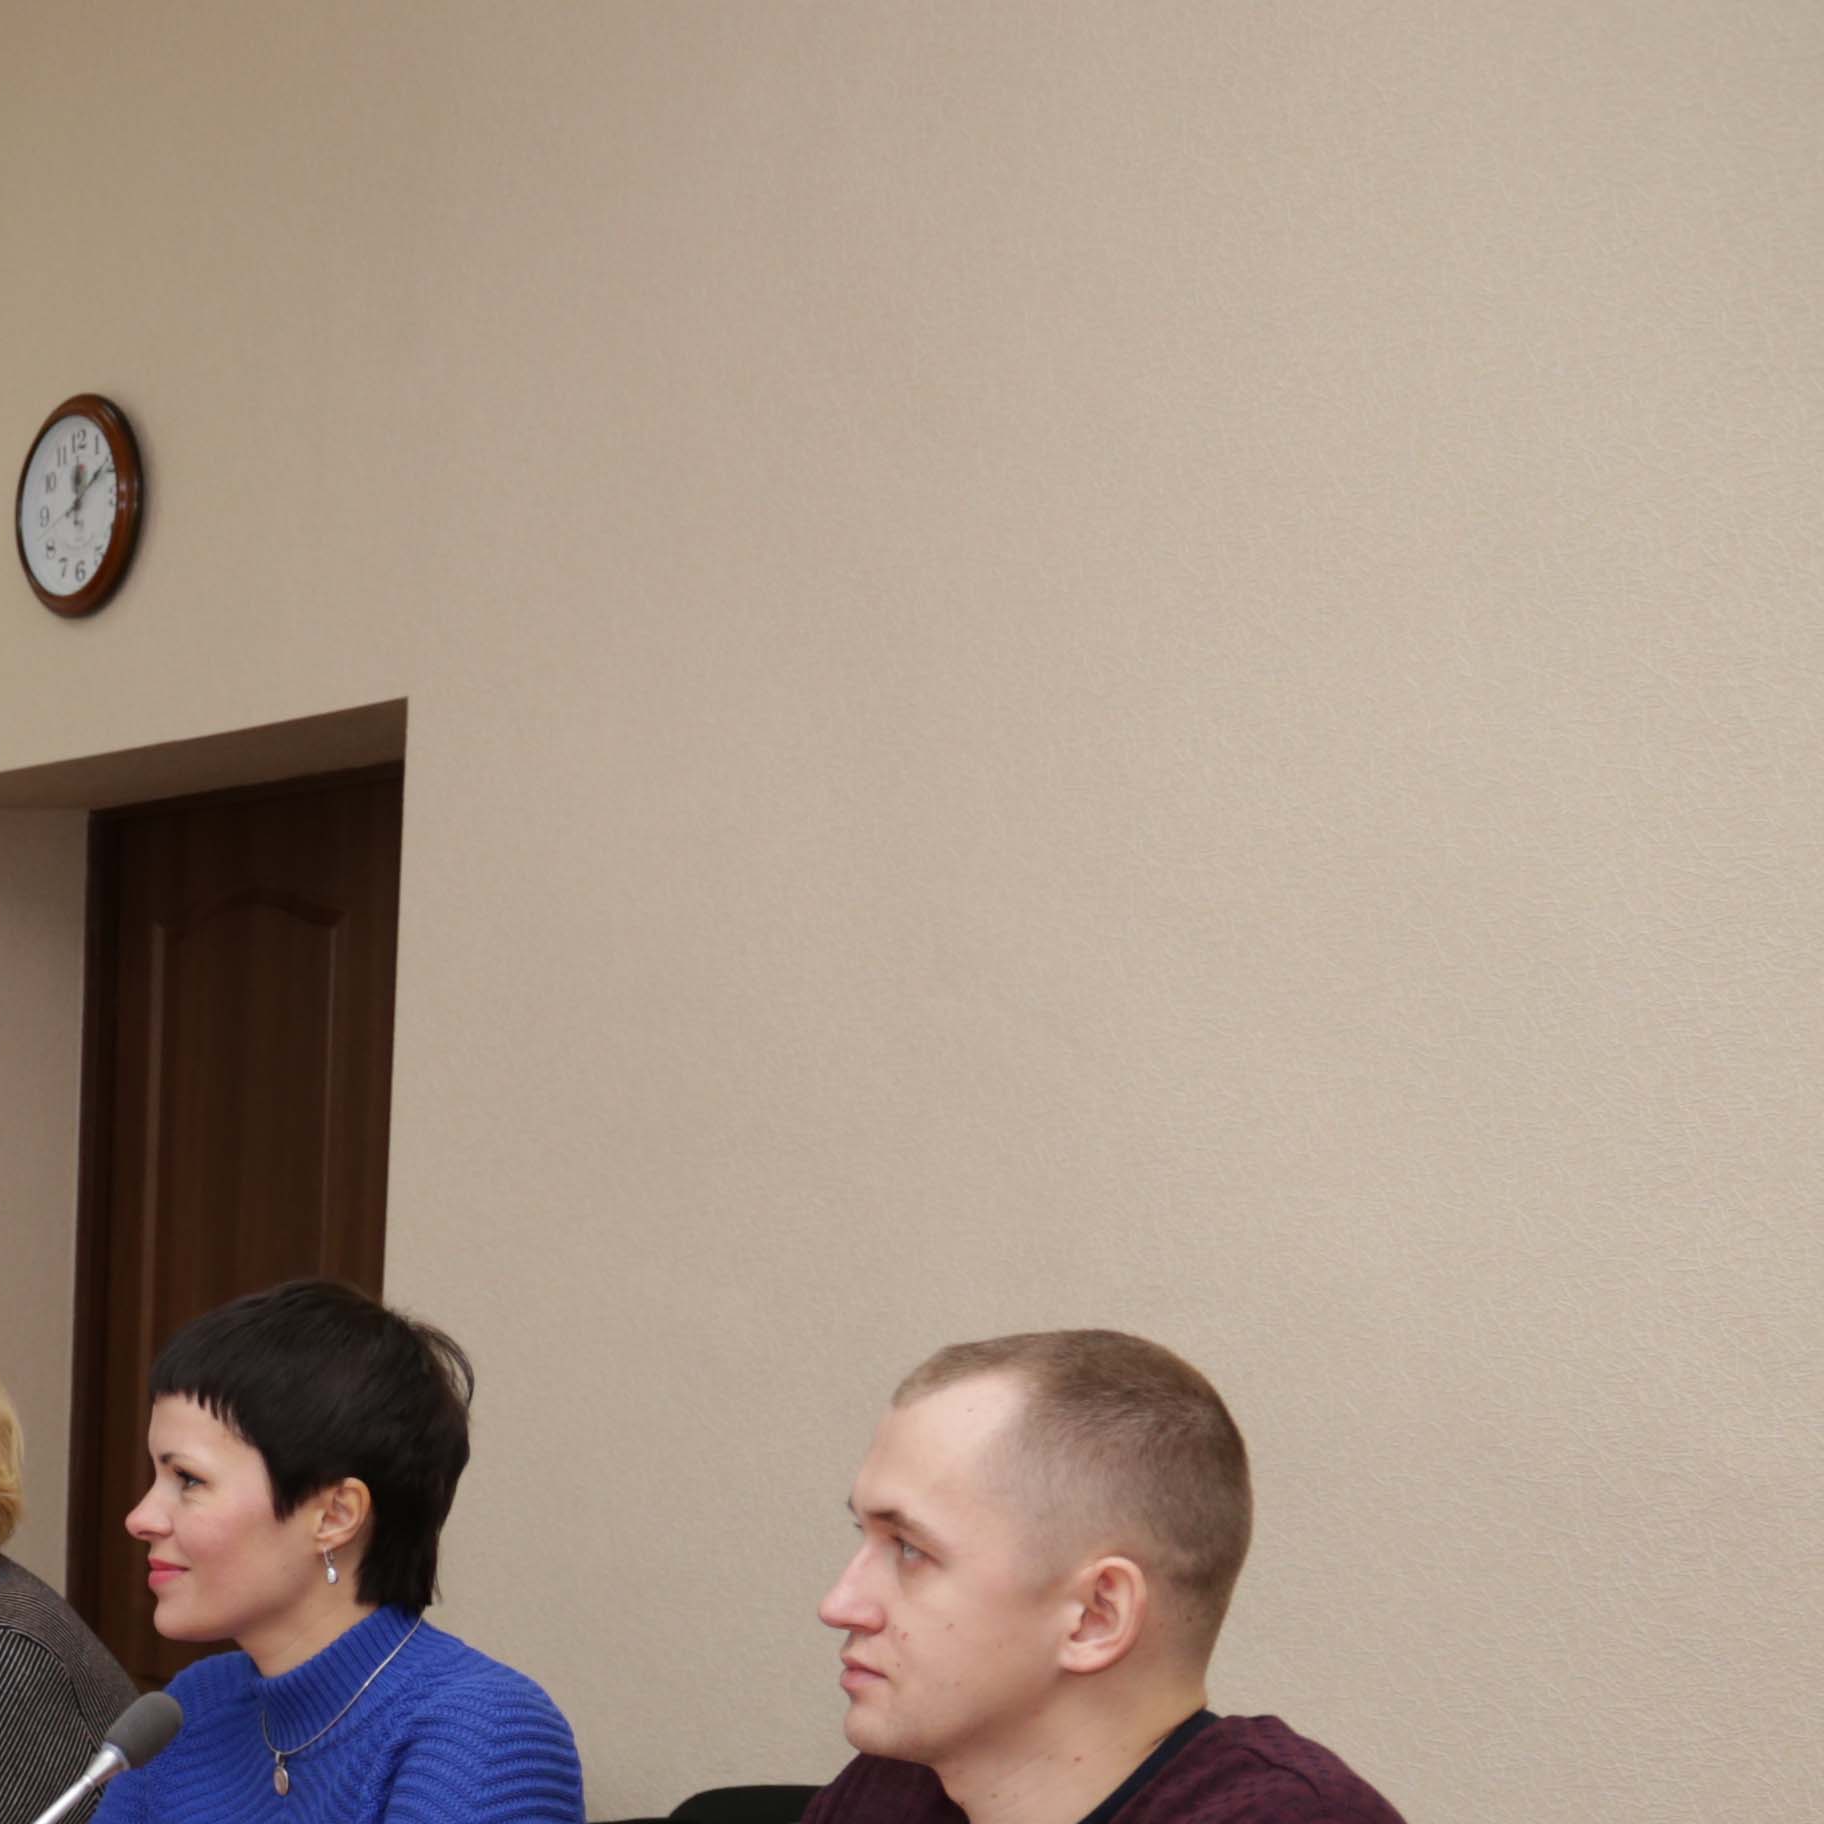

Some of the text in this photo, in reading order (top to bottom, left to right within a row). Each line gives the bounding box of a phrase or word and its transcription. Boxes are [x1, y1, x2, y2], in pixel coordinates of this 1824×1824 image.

[71, 429, 87, 454] 12
[56, 446, 67, 467] 11
[44, 471, 56, 494] 10
[40, 506, 50, 528] 9
[45, 538, 57, 560] 8
[59, 557, 68, 579] 7
[75, 560, 86, 583] 6
